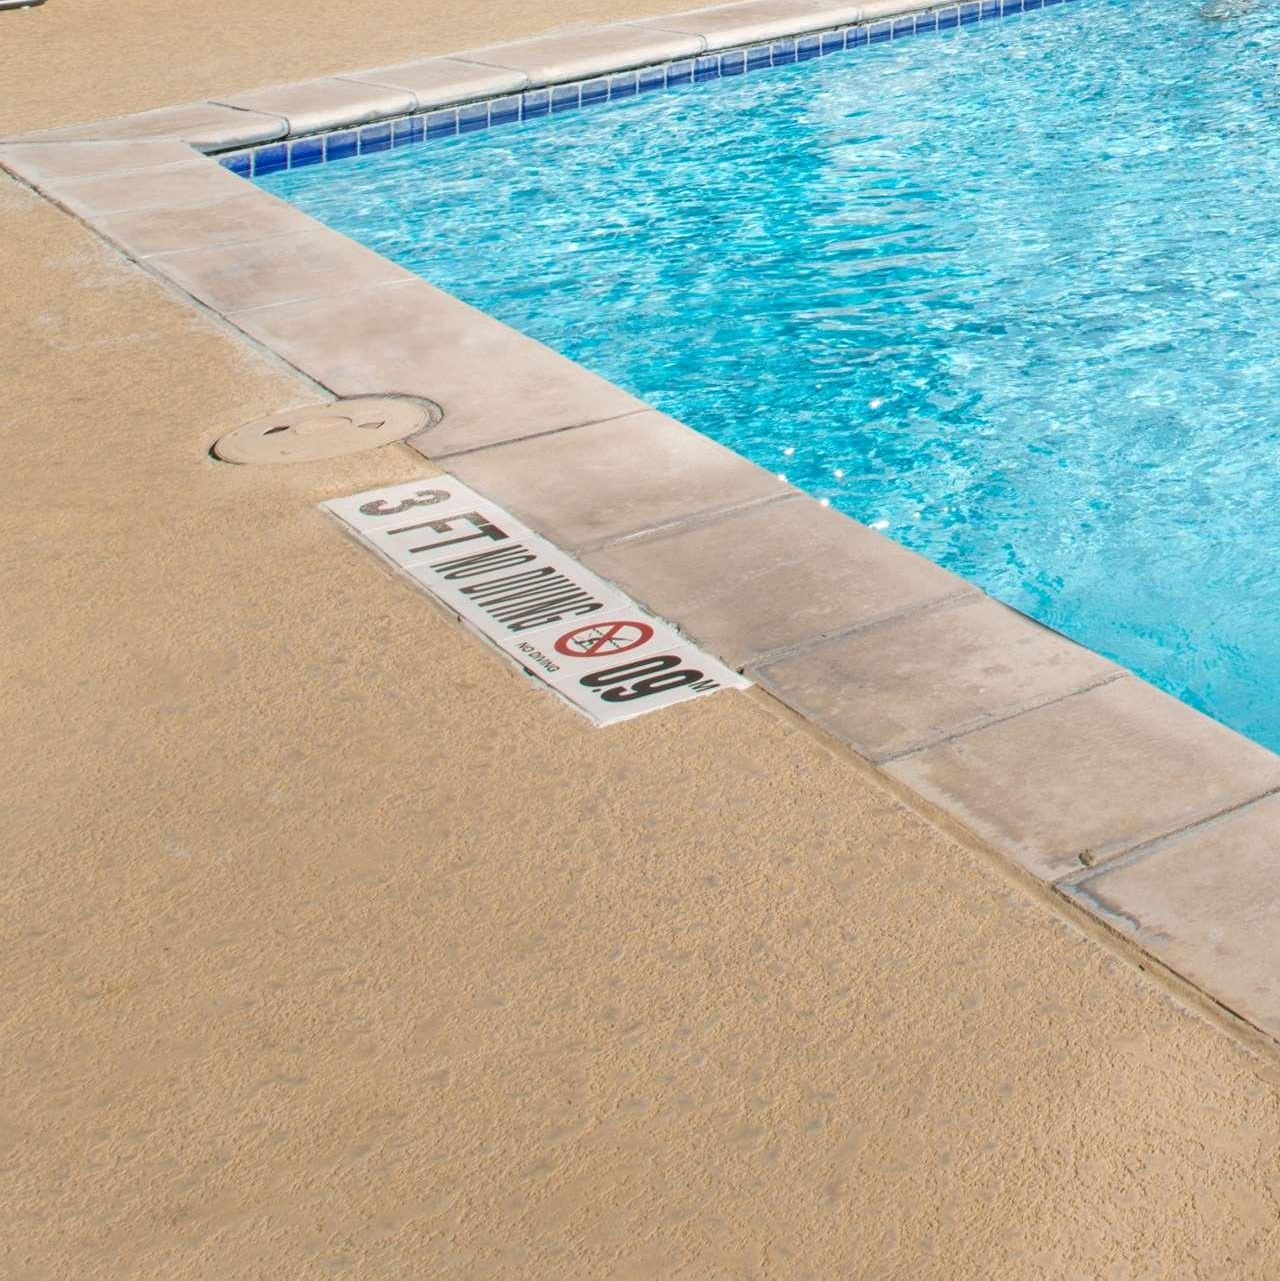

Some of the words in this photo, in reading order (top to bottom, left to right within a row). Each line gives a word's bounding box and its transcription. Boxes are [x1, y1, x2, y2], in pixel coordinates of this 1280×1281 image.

[359, 489, 452, 516] 3
[386, 510, 509, 554] FT
[430, 544, 538, 581] NO
[459, 566, 604, 632] DIVING
[518, 641, 534, 653] NO
[528, 650, 561, 674] DIVING
